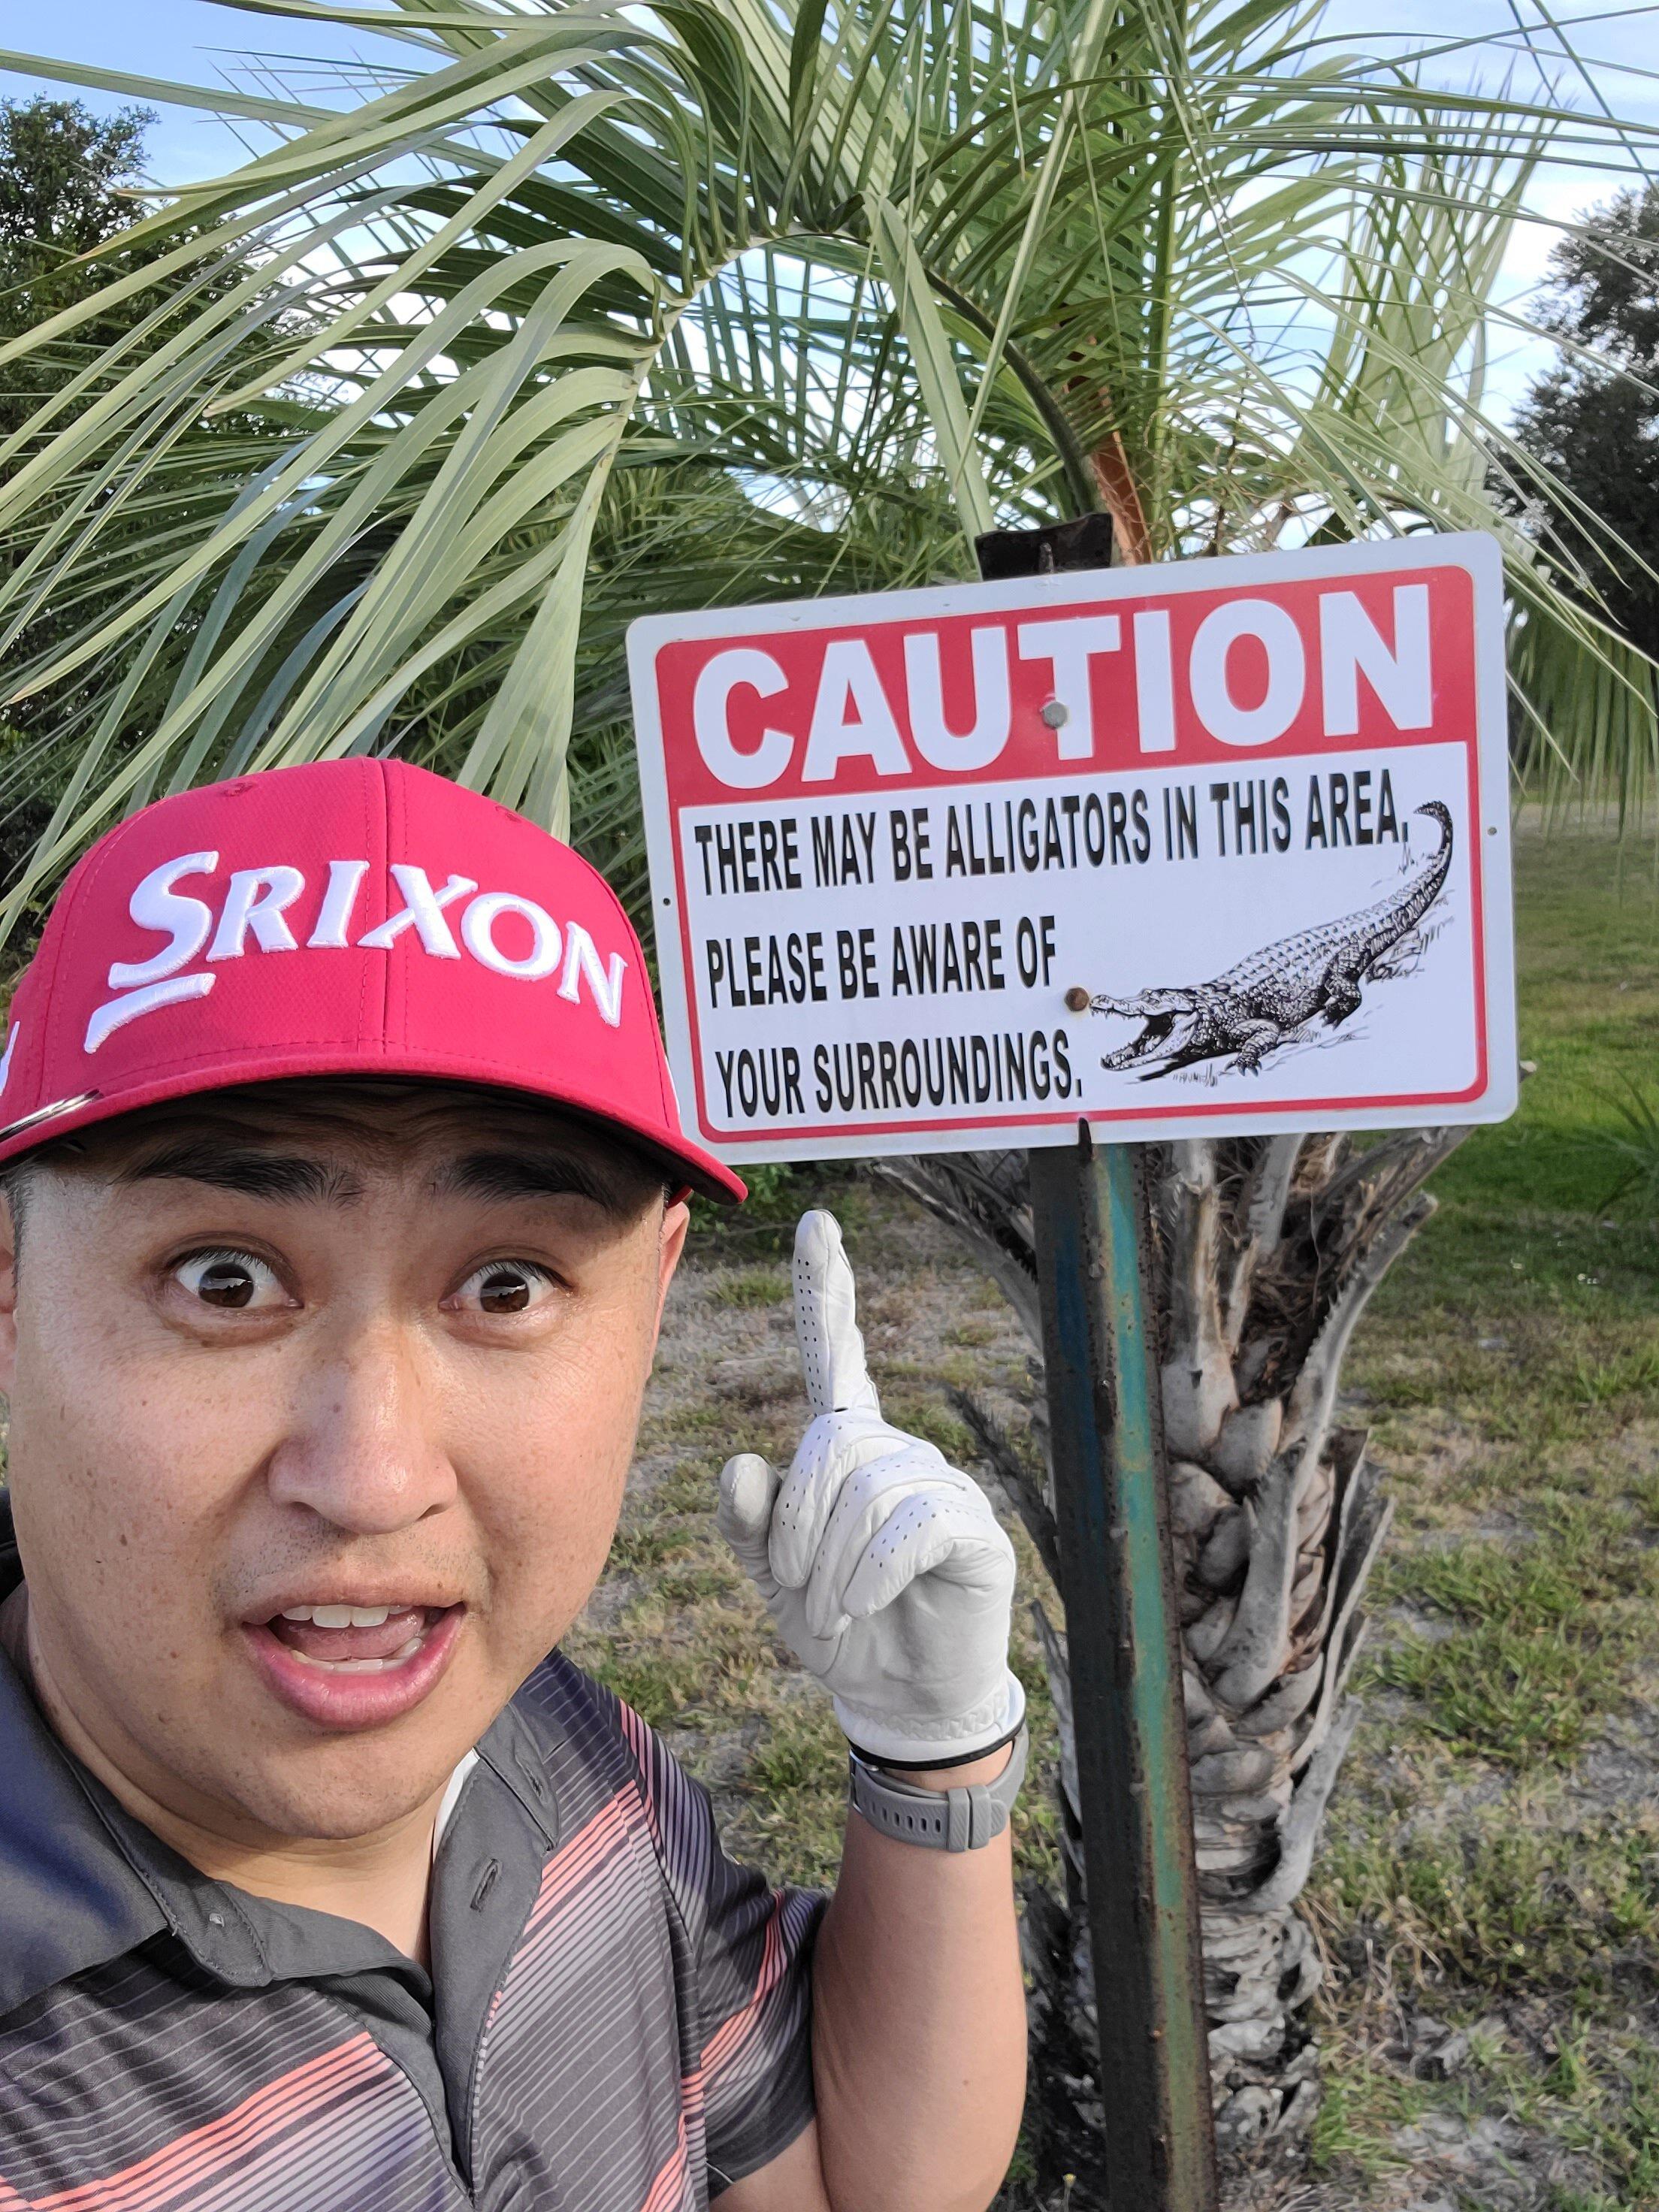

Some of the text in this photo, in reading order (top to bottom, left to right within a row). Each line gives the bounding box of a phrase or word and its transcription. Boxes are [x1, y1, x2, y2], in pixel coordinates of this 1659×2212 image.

[693, 585, 1433, 789] CAUTION
[694, 769, 1408, 895] THERE MAY BE ALLIGATORS IN THIS AREA.
[107, 851, 628, 1028] SRIXON
[706, 915, 1056, 1008] PLEASE BE AWARE OF
[715, 1029, 1083, 1117] YOUR SURROUNDINGS.
